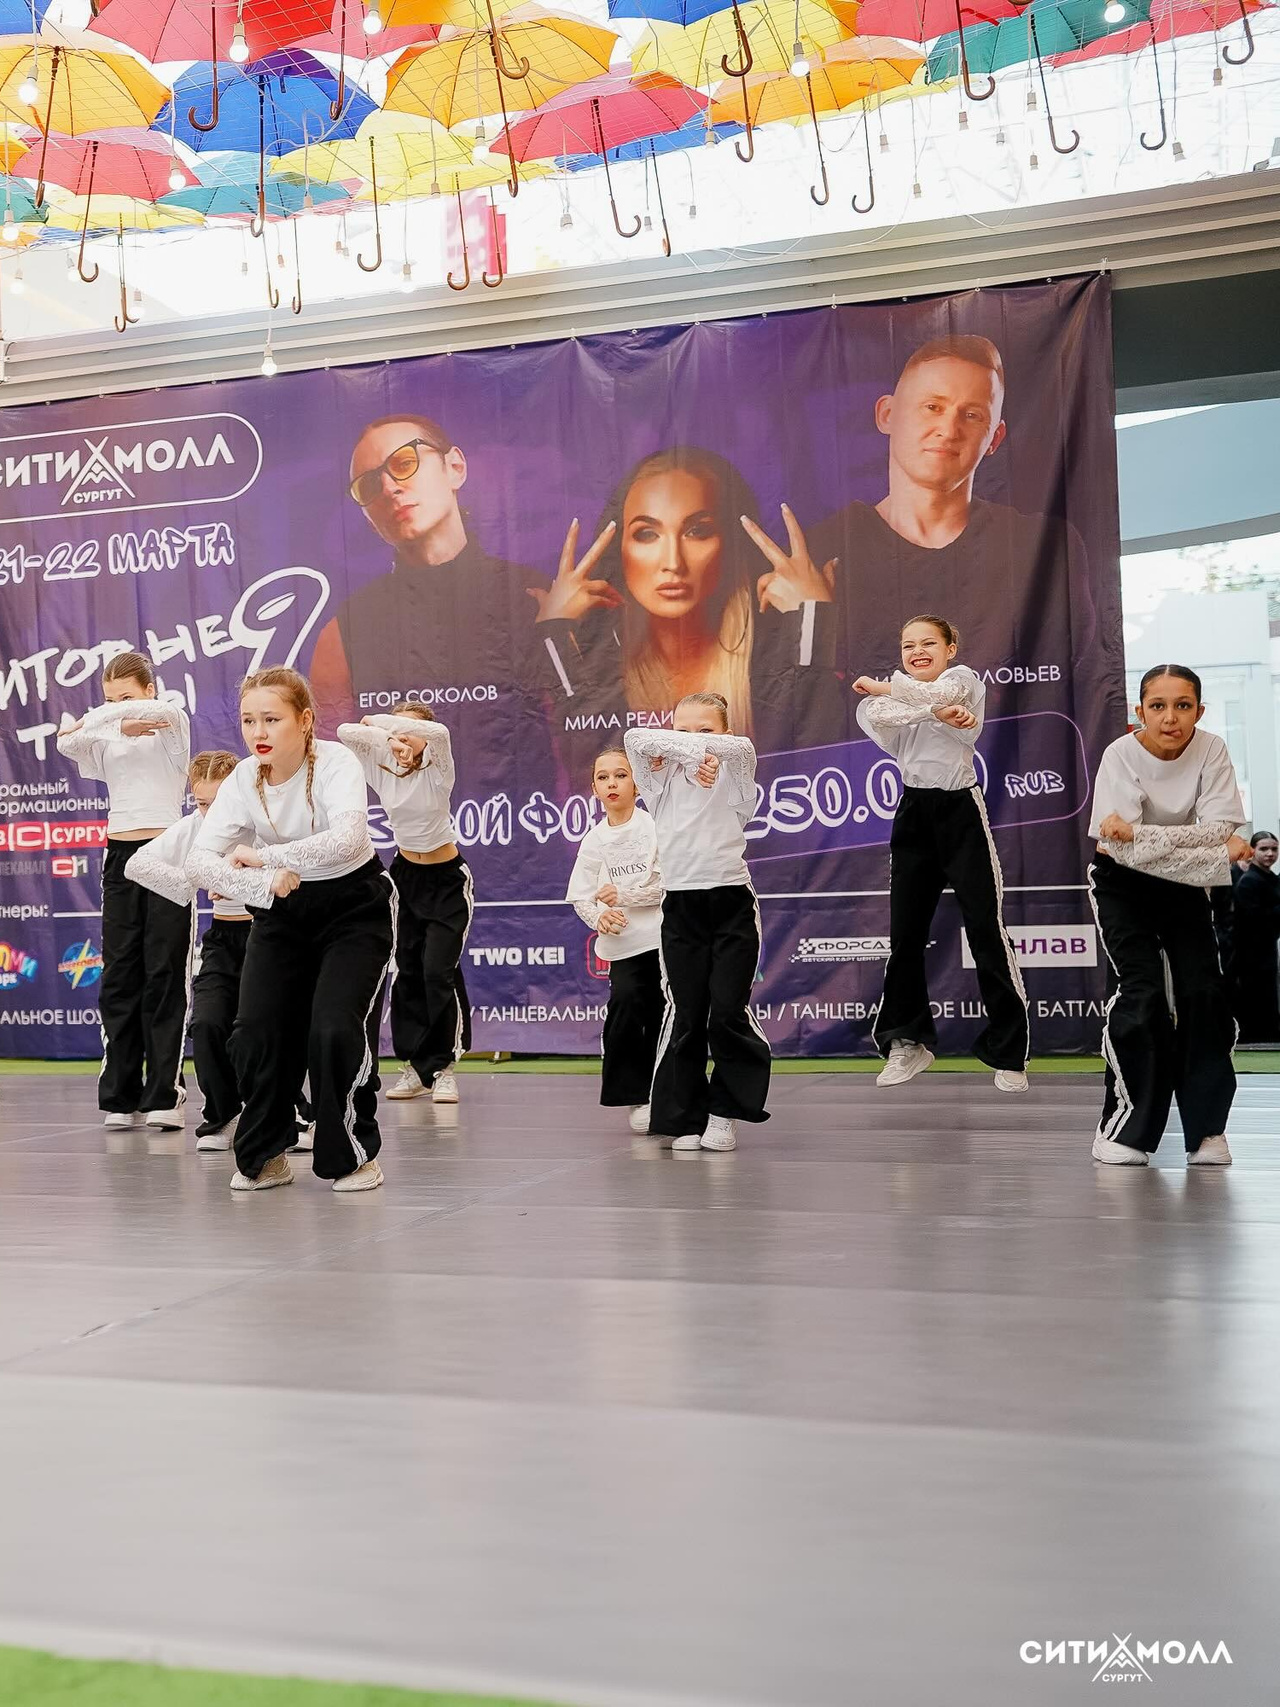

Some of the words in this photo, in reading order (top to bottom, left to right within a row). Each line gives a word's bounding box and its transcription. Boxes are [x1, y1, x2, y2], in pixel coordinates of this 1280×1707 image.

[114, 433, 235, 474] МОЛЛ
[73, 488, 123, 504] СУРГУТ
[108, 522, 236, 575] МАРТА
[359, 691, 401, 708] ЕГОР
[405, 685, 498, 704] СОКОЛОВ
[564, 713, 621, 731] МИЛА
[626, 710, 674, 728] РЕДИ
[1005, 771, 1065, 799] RUB
[51, 825, 108, 844] СУРГУ
[817, 940, 891, 951] ФОРСА
[469, 948, 523, 966] TWO
[527, 947, 565, 965] KEI
